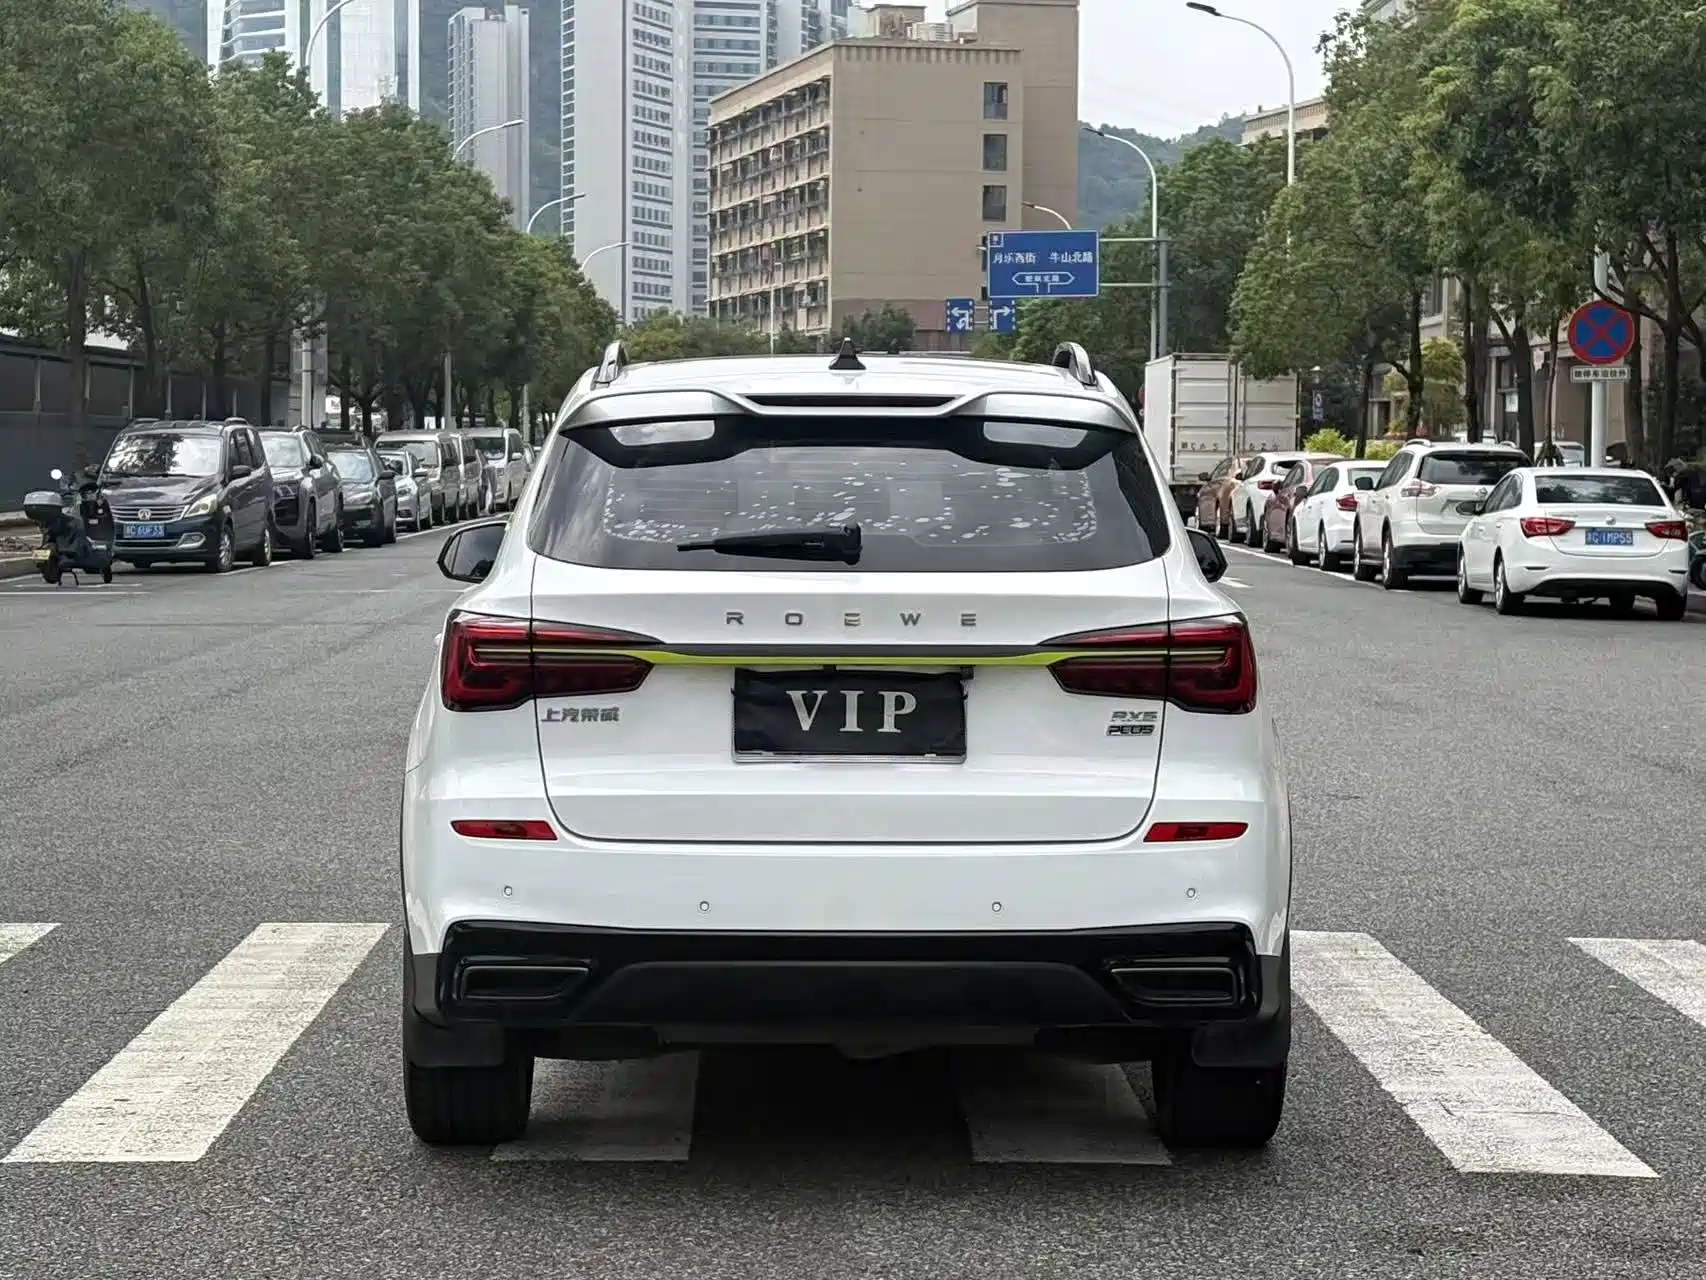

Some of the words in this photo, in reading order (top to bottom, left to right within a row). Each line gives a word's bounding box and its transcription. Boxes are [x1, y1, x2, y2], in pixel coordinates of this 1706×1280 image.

[726, 611, 977, 627] ROEWE
[541, 707, 619, 722] 上汽荣威
[785, 690, 917, 733] VIP
